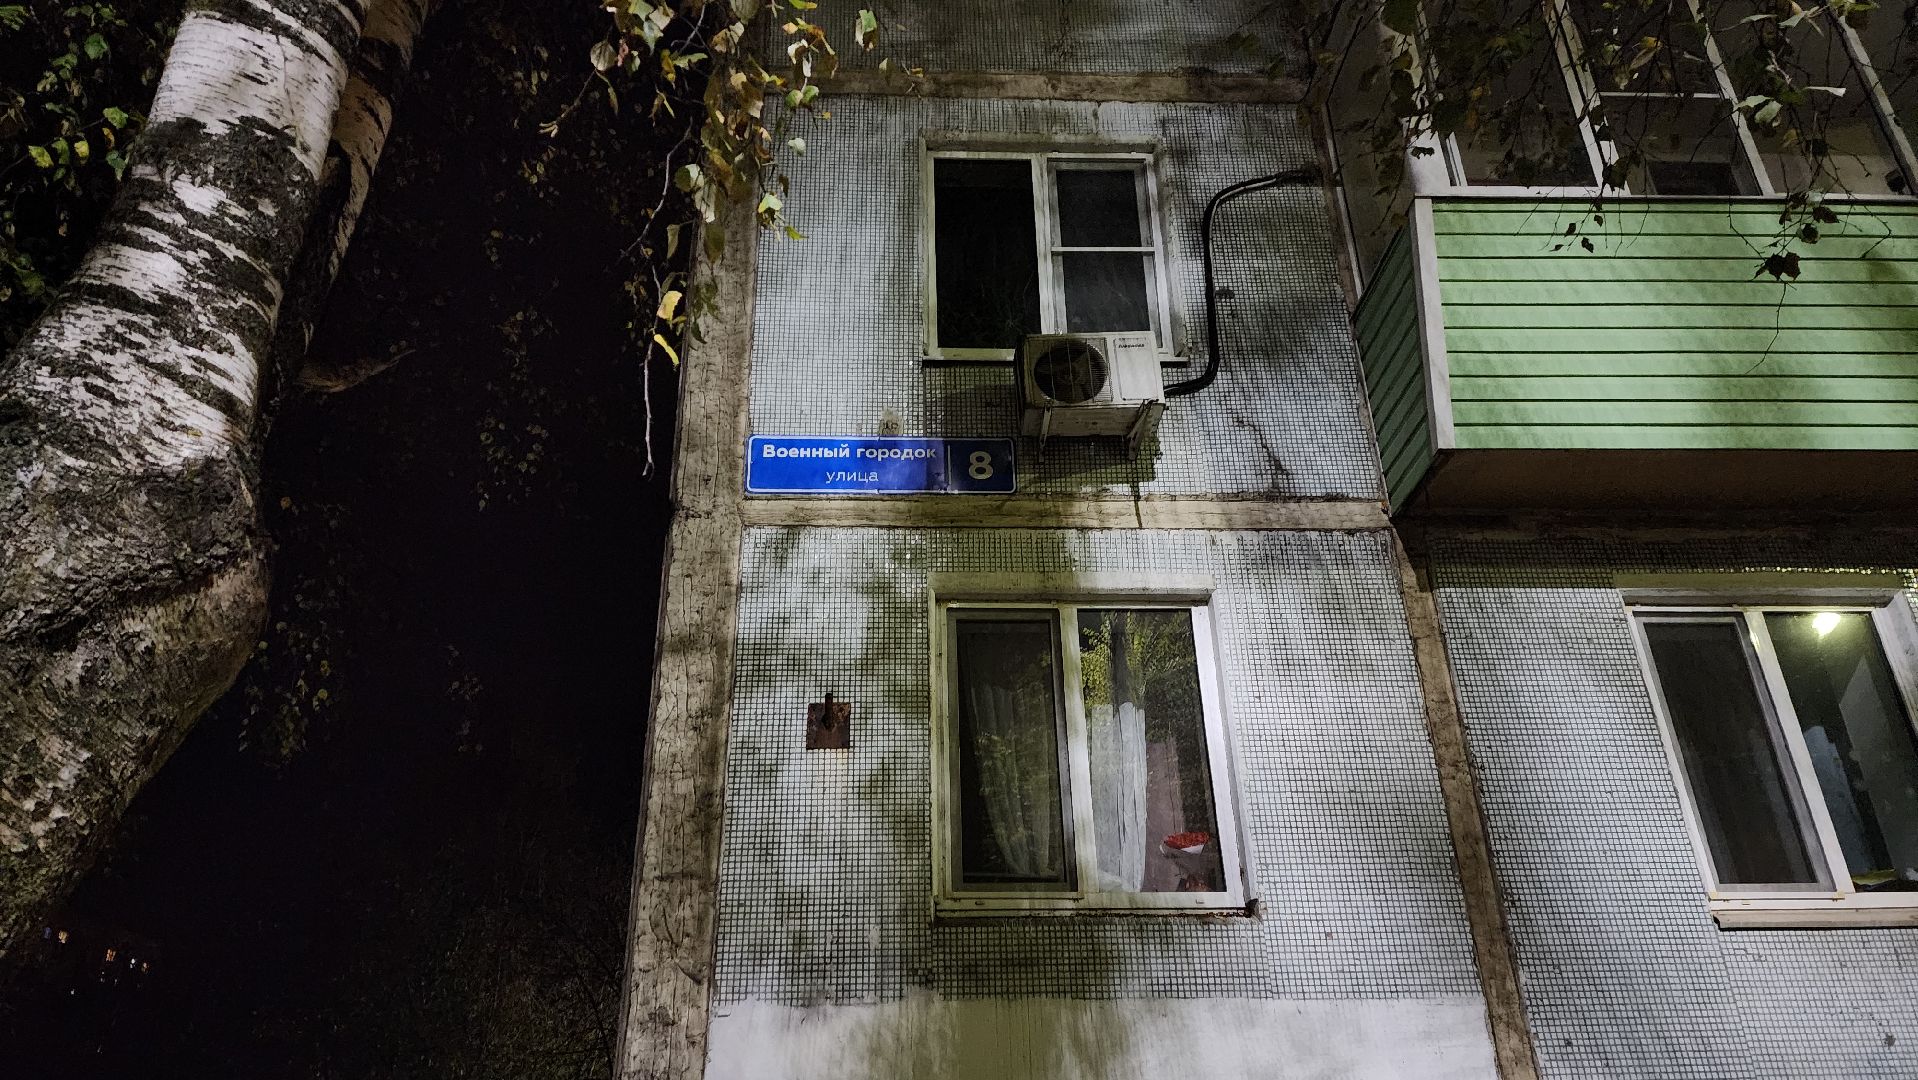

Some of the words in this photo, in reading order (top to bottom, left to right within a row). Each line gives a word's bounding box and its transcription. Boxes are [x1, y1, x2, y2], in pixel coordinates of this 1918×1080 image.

[762, 443, 850, 459] Военный
[856, 447, 937, 462] городок
[968, 450, 994, 480] 8
[825, 470, 879, 484] улица
